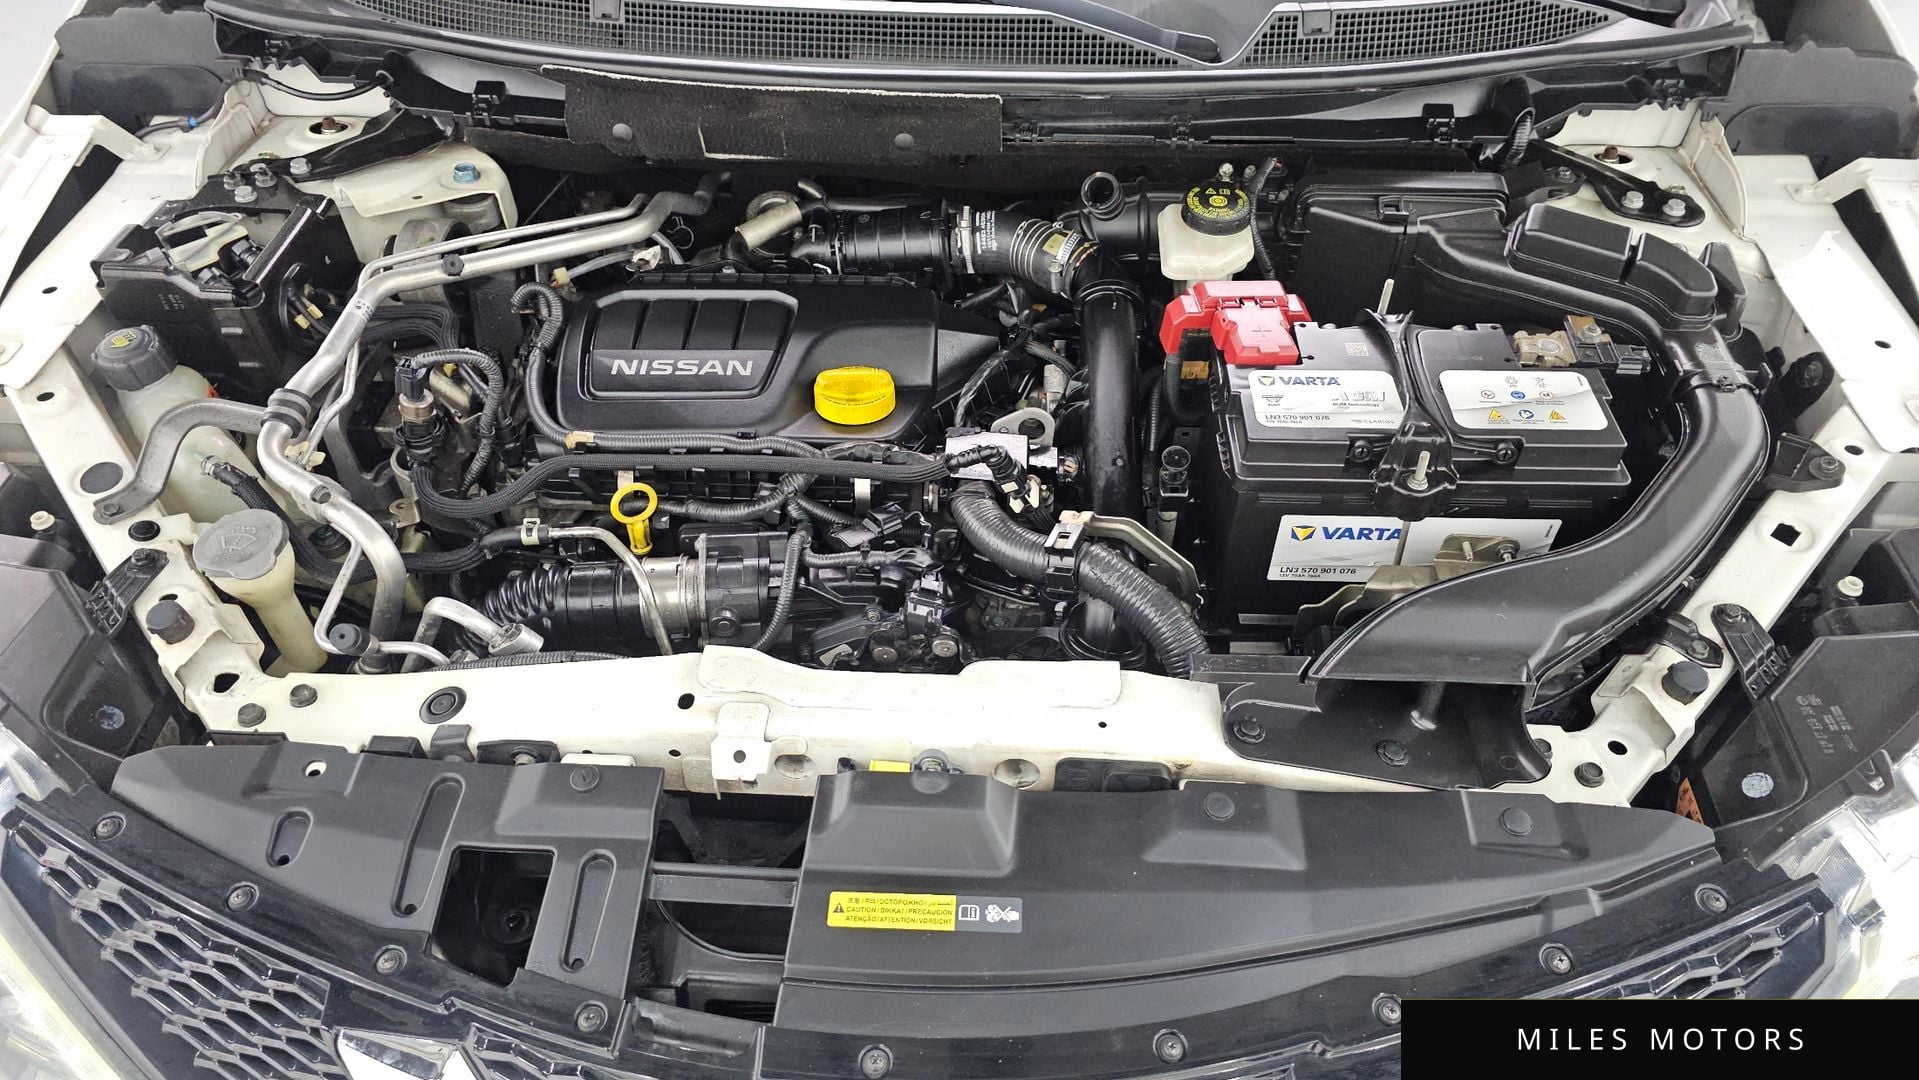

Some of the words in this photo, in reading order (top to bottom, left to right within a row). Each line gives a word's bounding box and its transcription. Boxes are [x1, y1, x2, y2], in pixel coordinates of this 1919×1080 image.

[610, 359, 753, 376] NISSAN
[1278, 376, 1341, 386] VARTA
[1321, 526, 1402, 541] VARTA
